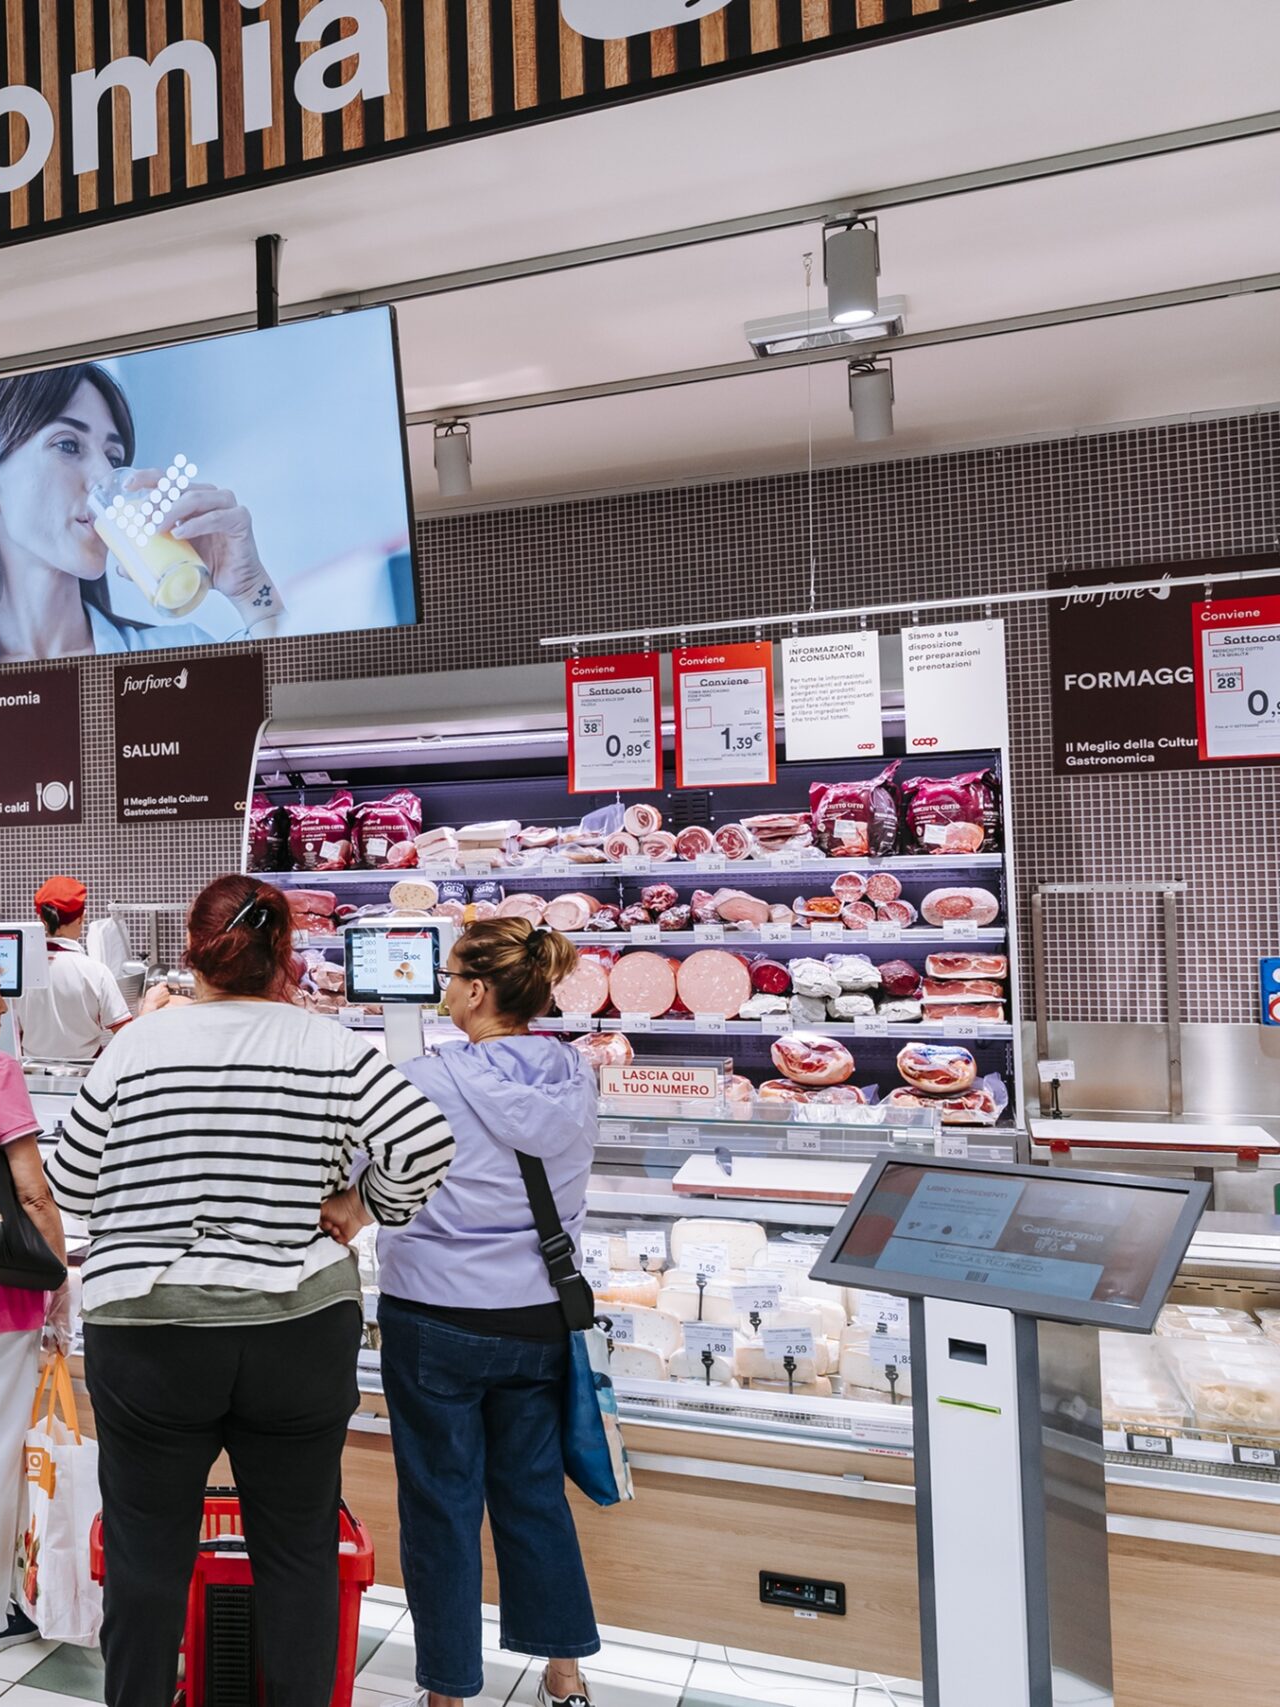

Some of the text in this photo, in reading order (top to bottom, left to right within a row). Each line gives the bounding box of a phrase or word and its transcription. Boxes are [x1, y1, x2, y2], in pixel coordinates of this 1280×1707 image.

[1201, 608, 1261, 622] Conviene
[944, 629, 959, 638] tua
[1224, 633, 1280, 646] Sottocos
[789, 644, 854, 656] INFORMAZIONI
[908, 640, 963, 652] disposizione
[679, 655, 726, 666] Conviene
[799, 651, 865, 663] CONSUMATORI
[908, 648, 981, 662] per preparazioni
[571, 665, 615, 676] Conviene
[917, 660, 972, 673] prenotazioni
[700, 677, 749, 687] Conviene
[1064, 666, 1194, 691] FORMAGG
[588, 686, 642, 696] Sottocosto
[720, 727, 762, 751] 1,39€
[912, 736, 938, 747] coop
[1066, 736, 1198, 754] Il Meglio della Cultur
[122, 741, 180, 759] SALUMI
[606, 735, 652, 758] 0,89€
[857, 742, 876, 750] coop
[1066, 752, 1155, 766] Gastronomica
[4, 801, 30, 813] caldi
[123, 794, 209, 808] Il Meglio della Cultura
[123, 807, 178, 817] Gastronomica
[622, 1070, 695, 1082] LASCIA QUI
[608, 1082, 709, 1096] IL TUO NUMERO
[1022, 1223, 1104, 1243] Gastronomia
[698, 1263, 716, 1273] 1,55
[753, 1300, 773, 1309] 2,29
[879, 1312, 899, 1322] 2,39
[706, 1343, 727, 1352] 1,89
[786, 1345, 807, 1354] 2,59
